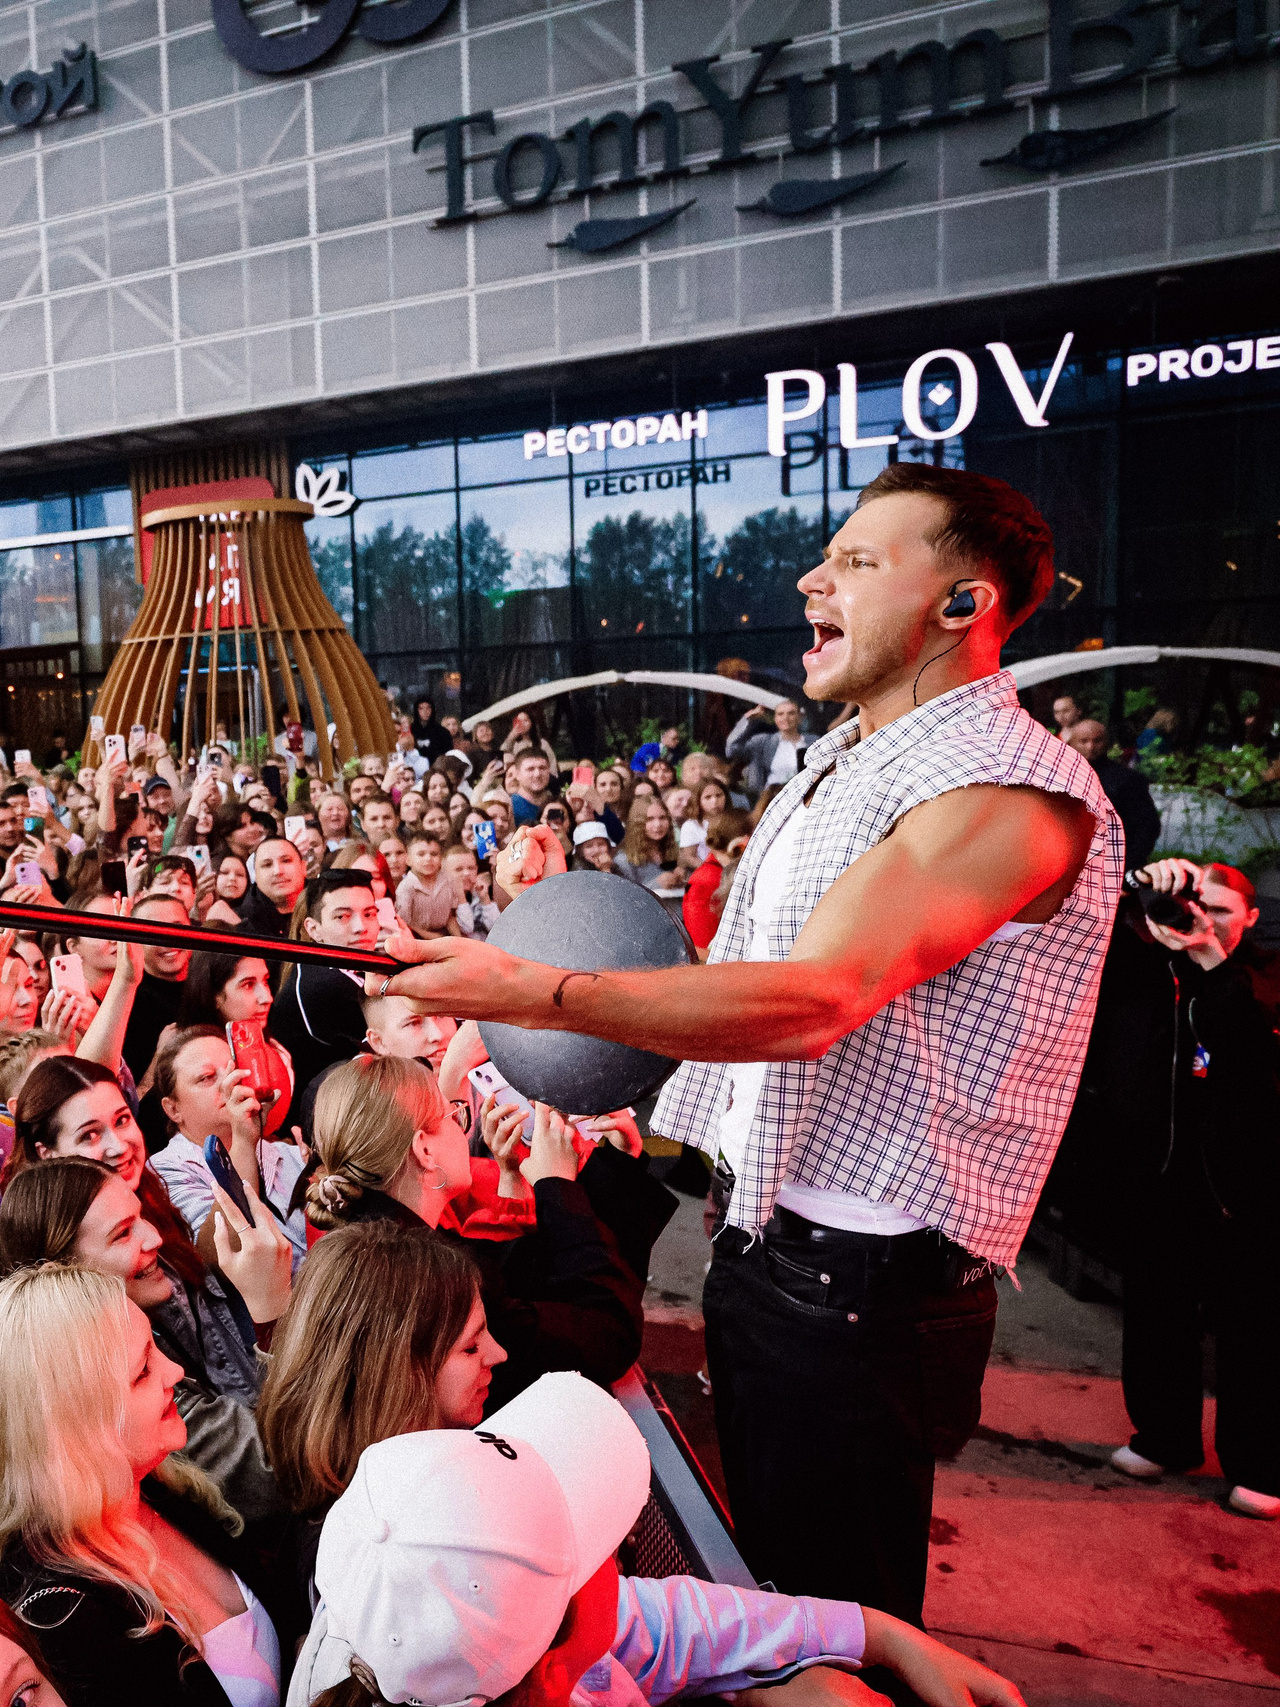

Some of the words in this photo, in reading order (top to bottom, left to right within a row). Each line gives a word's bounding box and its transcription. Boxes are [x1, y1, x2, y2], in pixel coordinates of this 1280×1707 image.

[1126, 334, 1280, 387] PROJE
[764, 331, 1075, 457] PLOV
[523, 409, 709, 460] РЕСТОРАН
[584, 462, 731, 498] РЕСТОРАН
